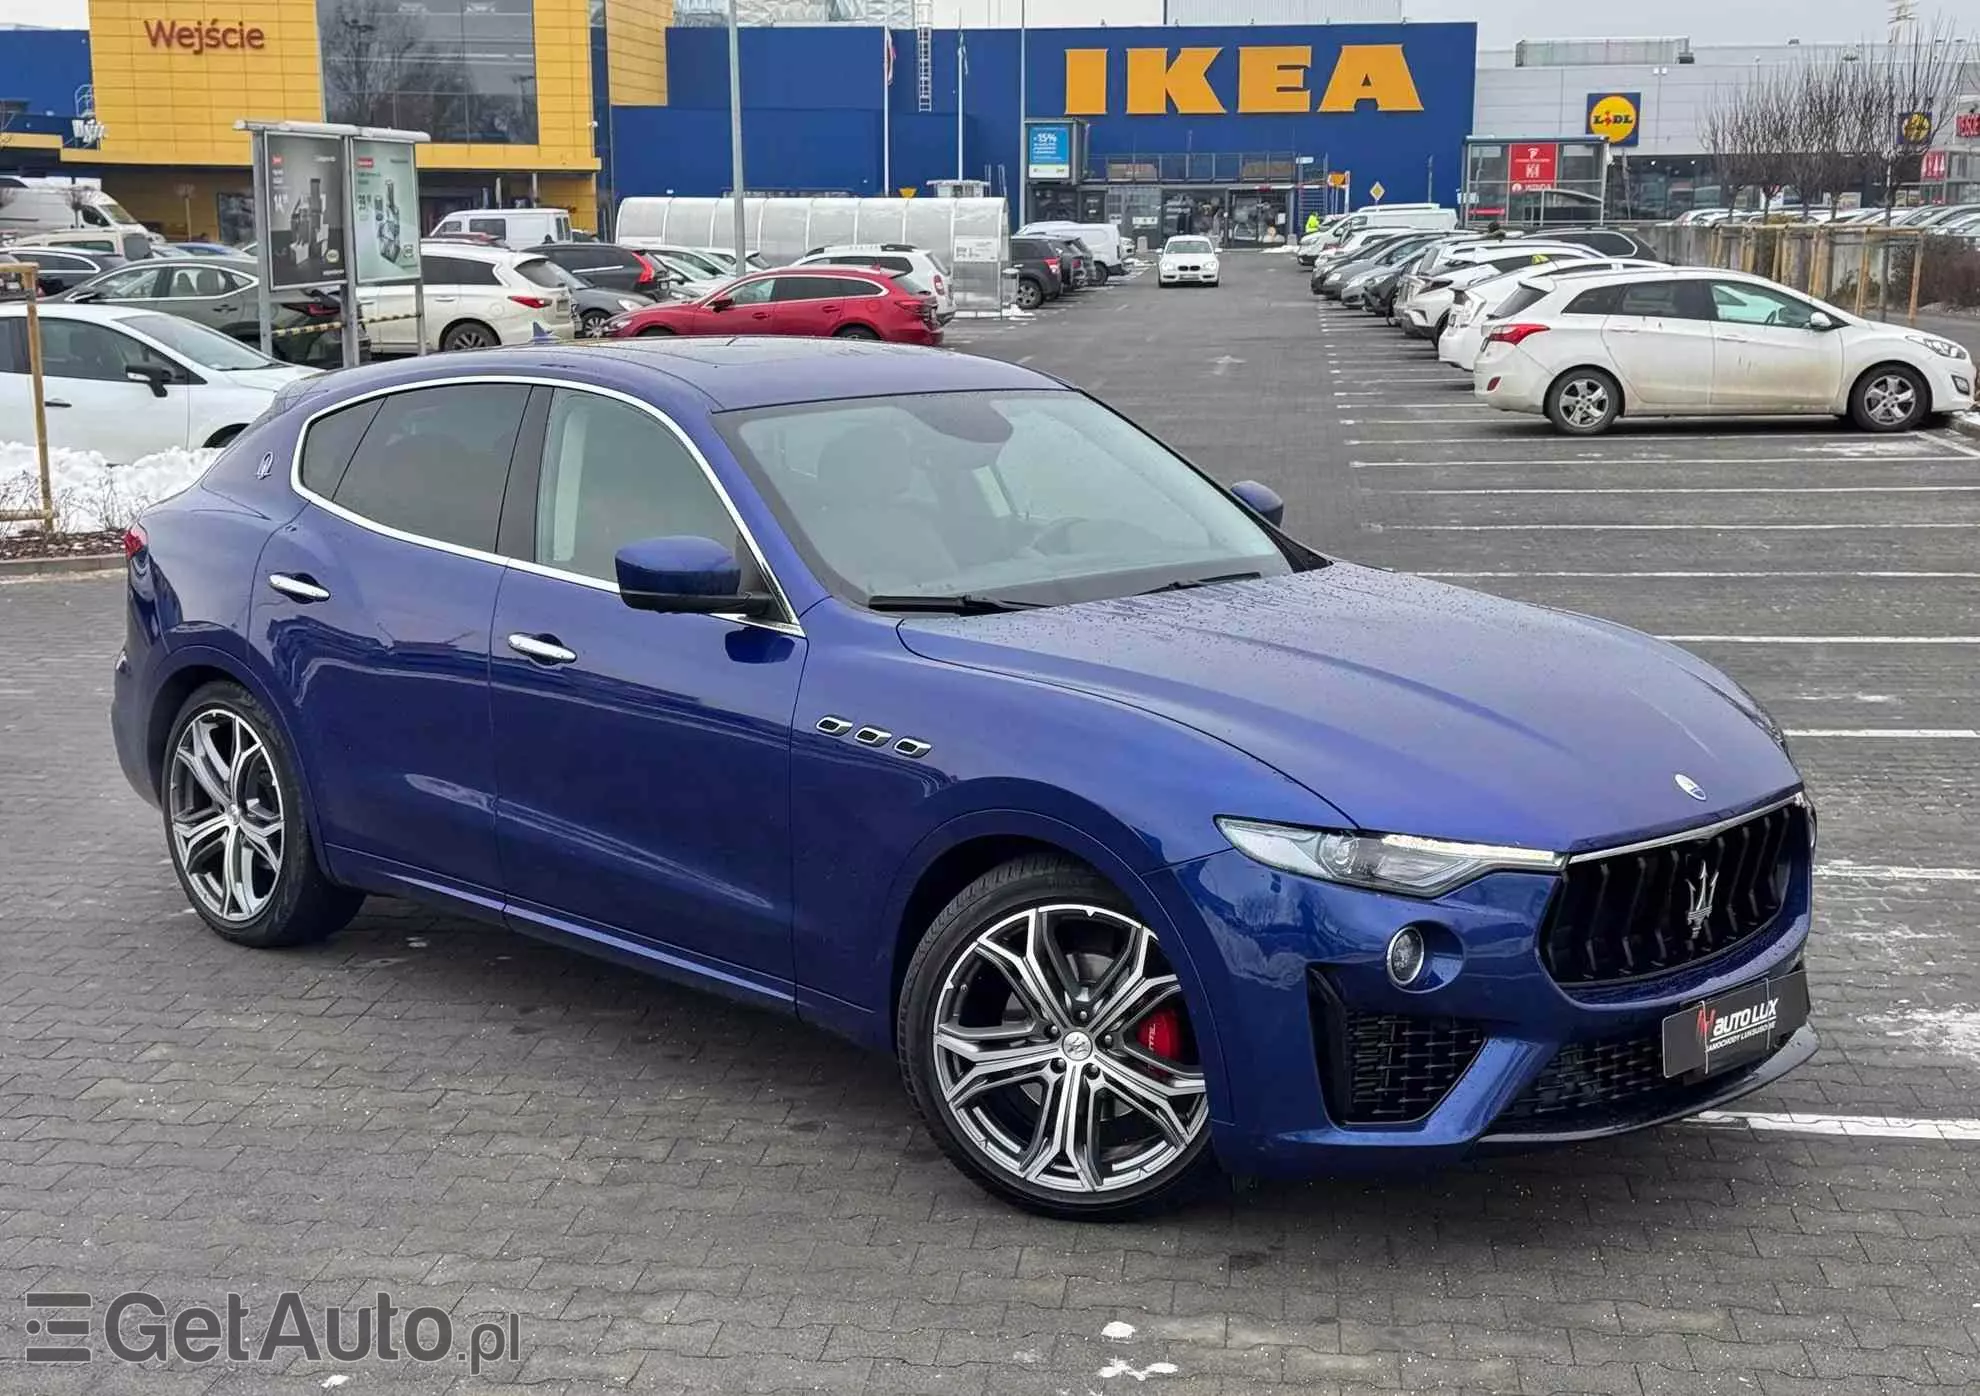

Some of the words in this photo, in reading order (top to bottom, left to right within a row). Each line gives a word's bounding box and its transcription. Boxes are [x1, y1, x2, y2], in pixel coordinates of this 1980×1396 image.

[143, 18, 265, 56] Wejście
[1064, 44, 1424, 115] IKEA
[1752, 998, 1779, 1022] LUX
[1705, 1035, 1742, 1052] AMOCHODY
